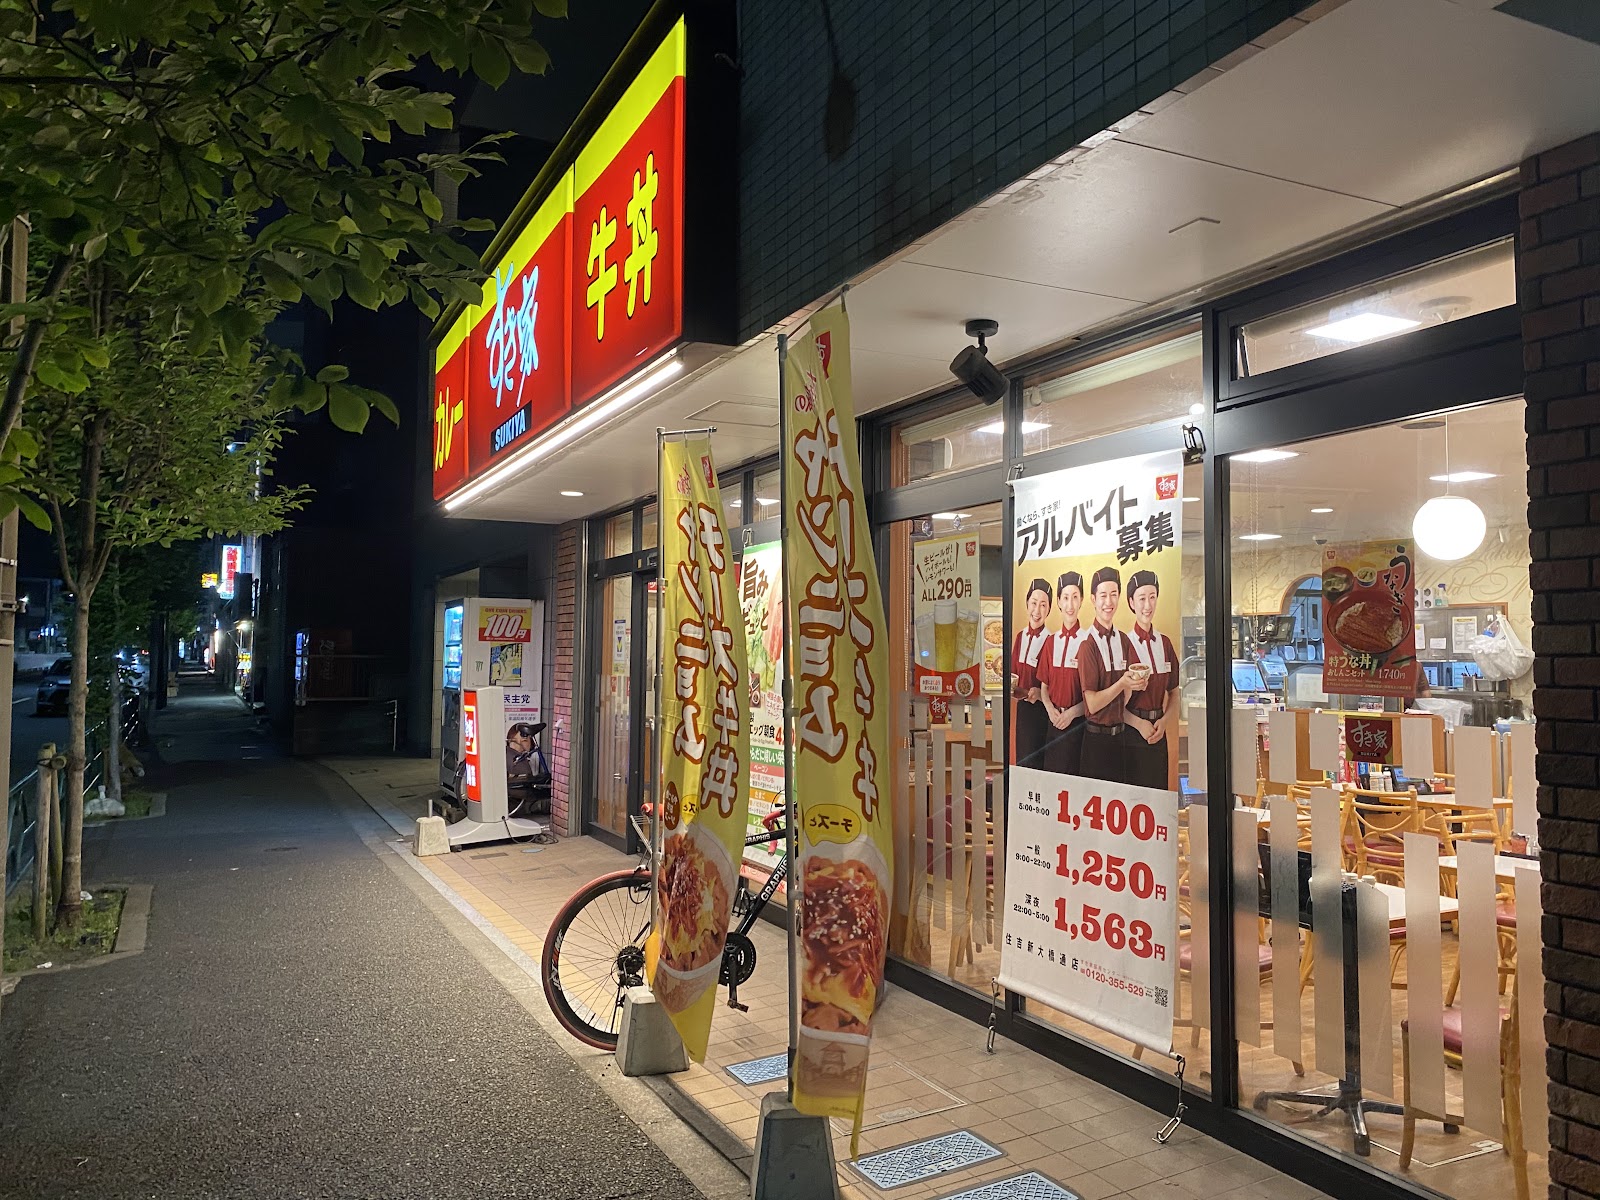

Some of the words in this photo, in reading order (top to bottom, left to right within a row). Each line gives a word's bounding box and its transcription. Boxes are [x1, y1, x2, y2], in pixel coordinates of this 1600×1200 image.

[587, 151, 658, 341] 牛丼
[486, 261, 539, 408] すき家
[434, 386, 464, 472] カレー
[494, 408, 527, 452] SUKIYA
[1016, 485, 1138, 567] アルバイト
[1116, 511, 1175, 566] 募集
[743, 558, 769, 603] 旨み
[921, 588, 937, 602] ALL
[937, 576, 972, 601] 290円
[1383, 544, 1411, 615] うなぎ
[483, 613, 528, 639] 100円
[1327, 669, 1366, 678] おしんこセット
[1328, 651, 1372, 669] 特うな丼
[504, 693, 531, 704] 民主党
[1350, 719, 1388, 752] すき家
[1018, 802, 1050, 817] 5:00-9:00
[1057, 790, 1168, 842] 1,400円
[760, 858, 787, 901] GRAPHIS
[1015, 852, 1051, 870] 9:00-22:00
[1056, 843, 1167, 901] 1,250円
[1013, 903, 1050, 923] 22:00-5:00
[1054, 896, 1166, 962] 1,563円
[1085, 968, 1144, 998] 0120-355-529
